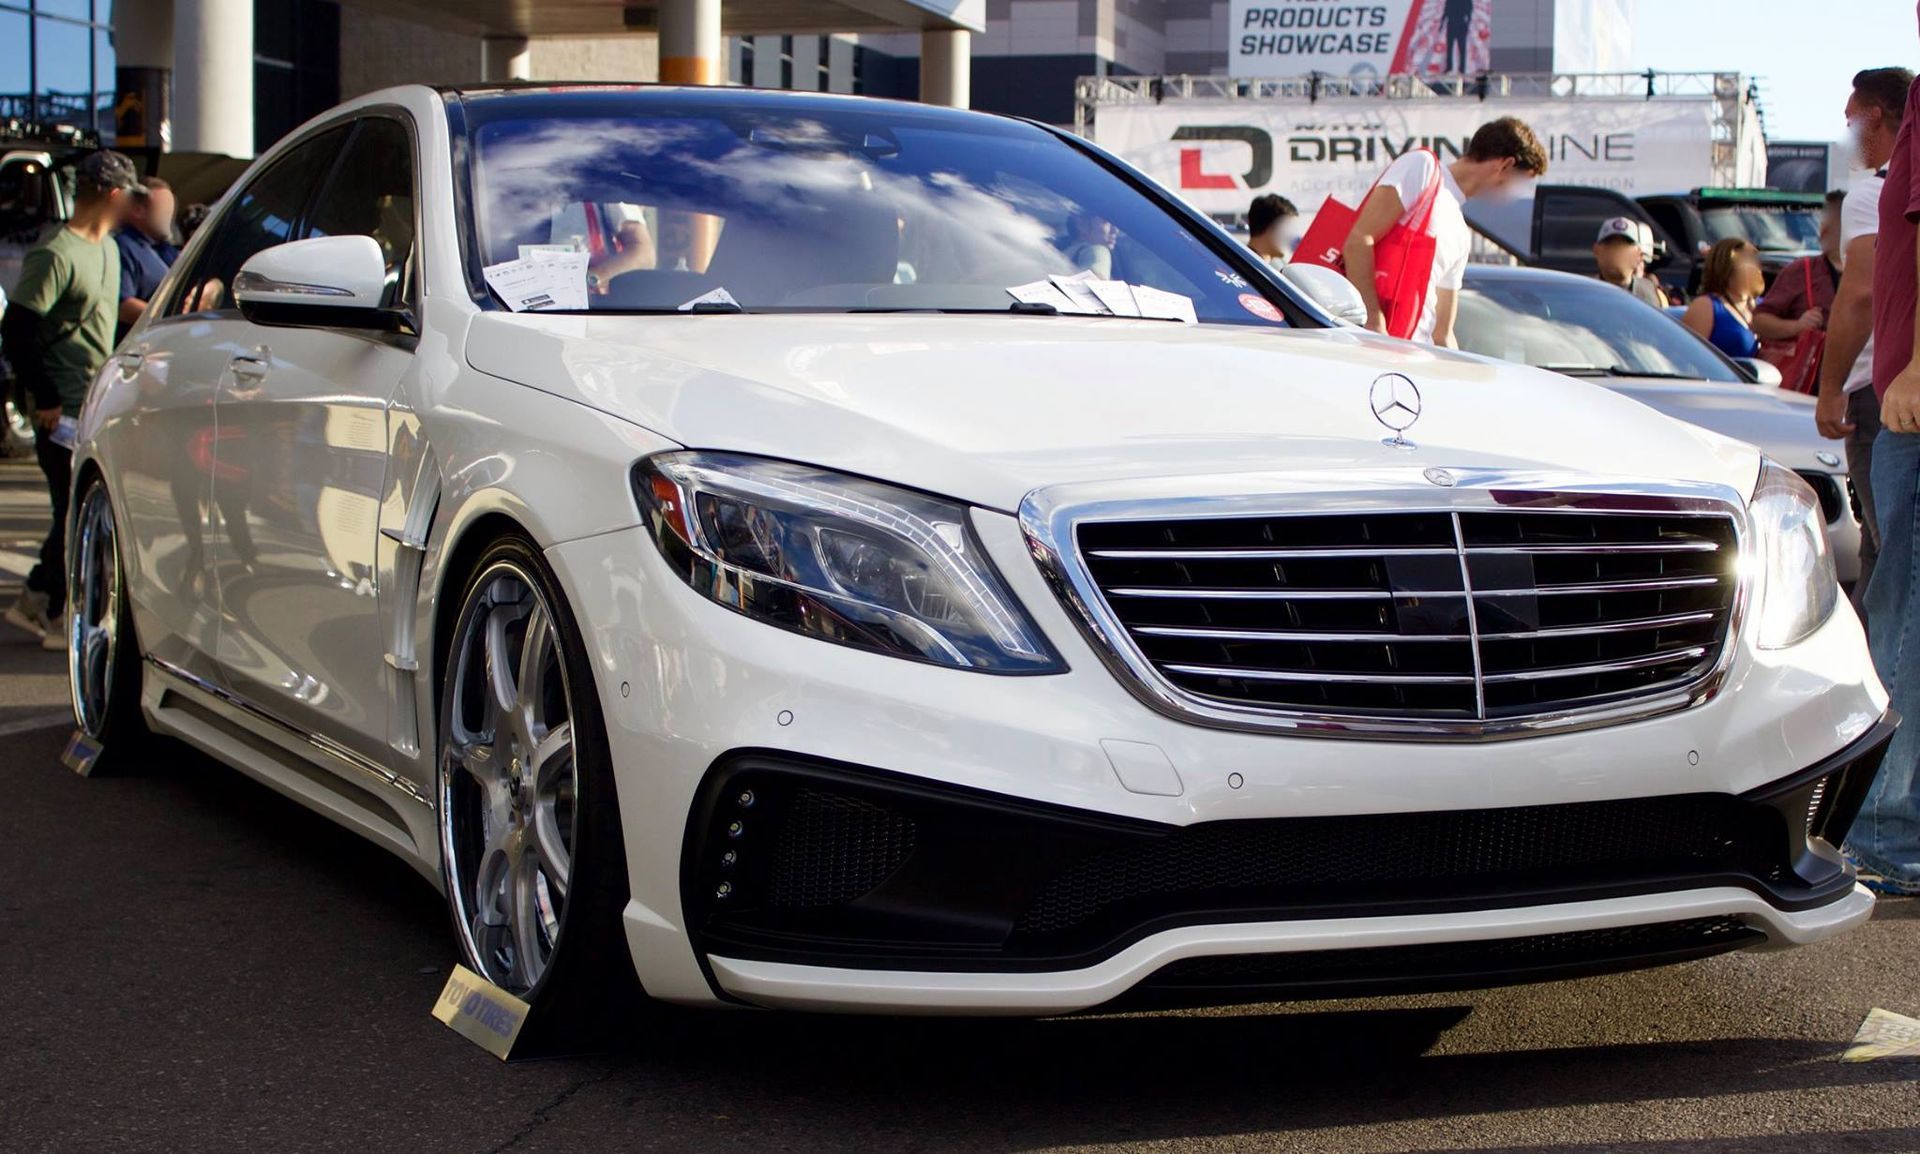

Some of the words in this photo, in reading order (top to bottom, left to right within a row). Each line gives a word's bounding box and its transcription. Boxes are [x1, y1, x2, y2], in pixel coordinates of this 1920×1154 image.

[1244, 7, 1387, 28] PRODUCTS
[1240, 33, 1391, 55] SHOWCASE
[1288, 136, 1471, 161] DRIVN
[1550, 133, 1635, 161] INE
